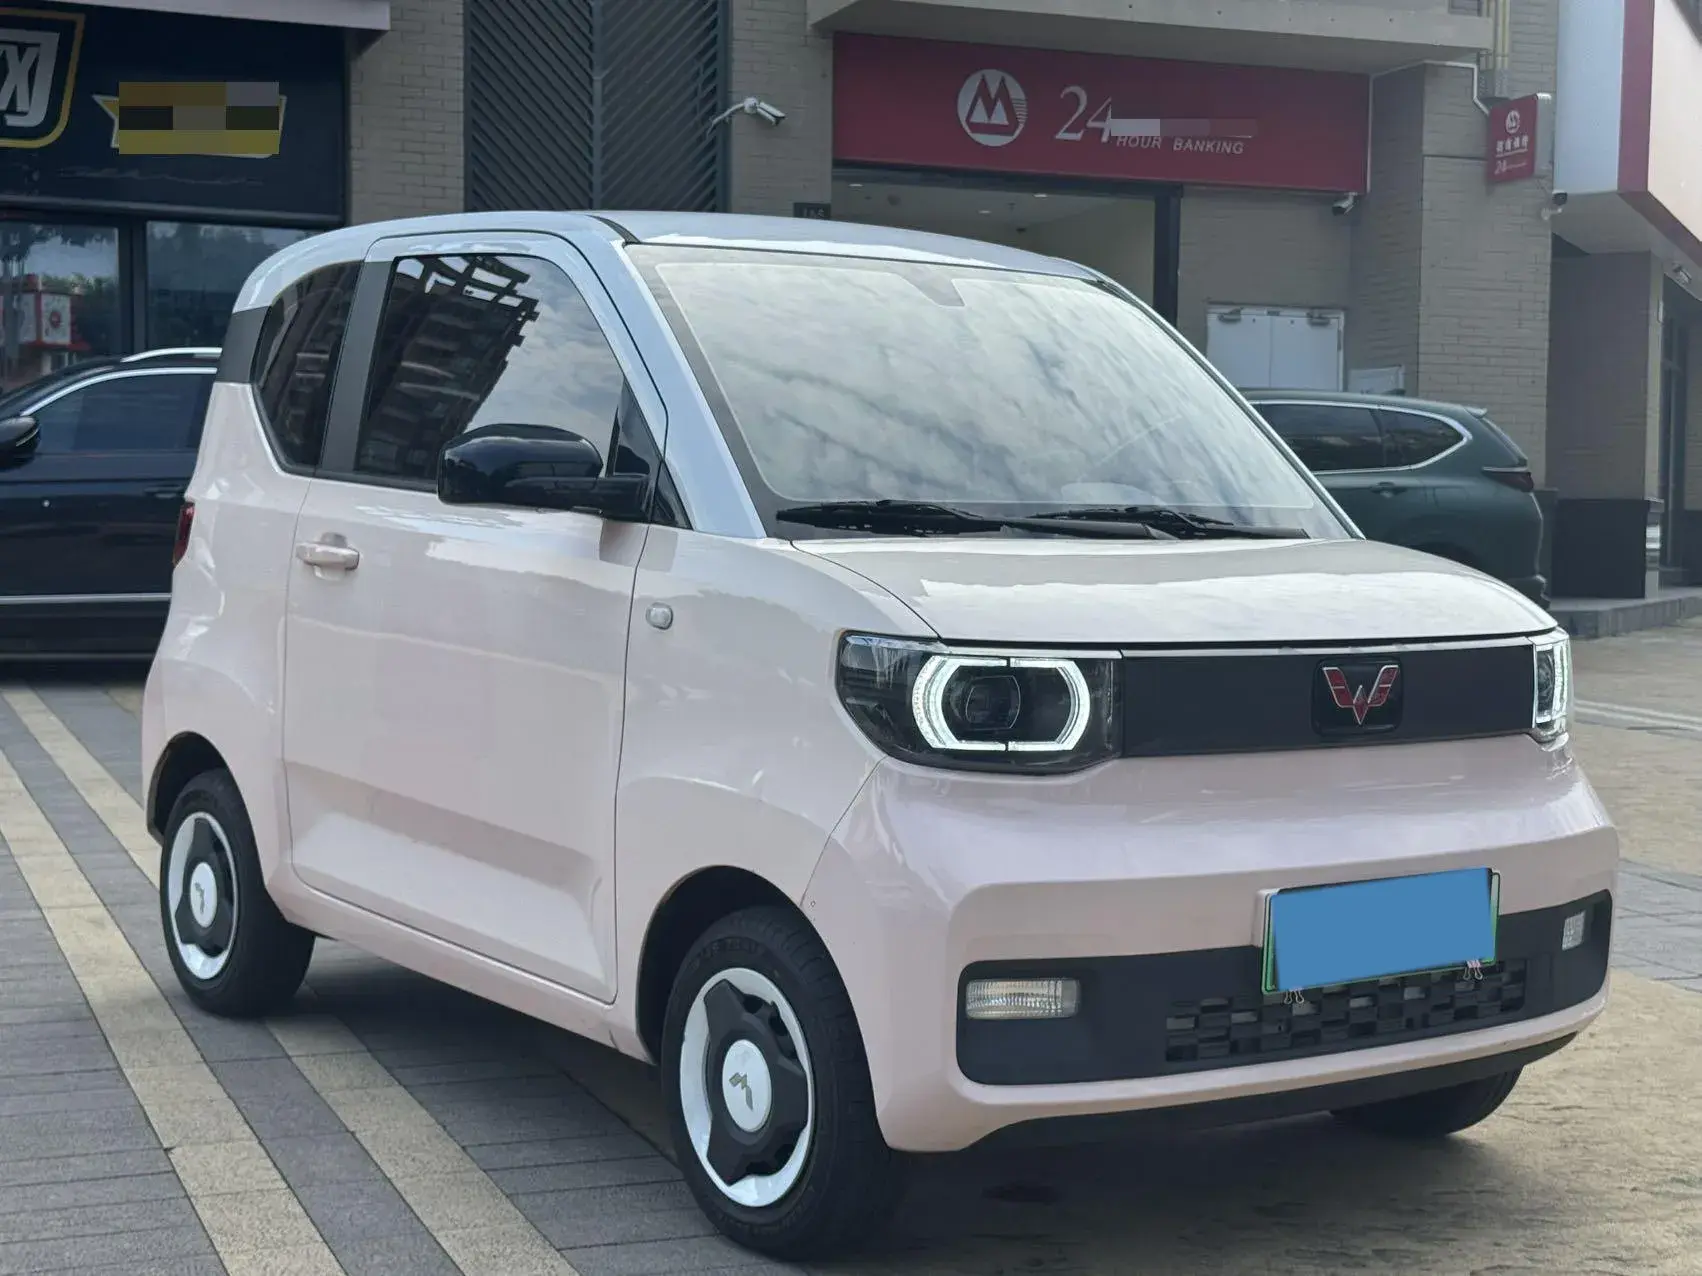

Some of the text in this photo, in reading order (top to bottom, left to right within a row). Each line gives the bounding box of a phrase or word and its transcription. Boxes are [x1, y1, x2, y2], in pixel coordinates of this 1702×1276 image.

[1054, 85, 1110, 143] 24
[1116, 135, 1244, 155] HOUR BANKING
